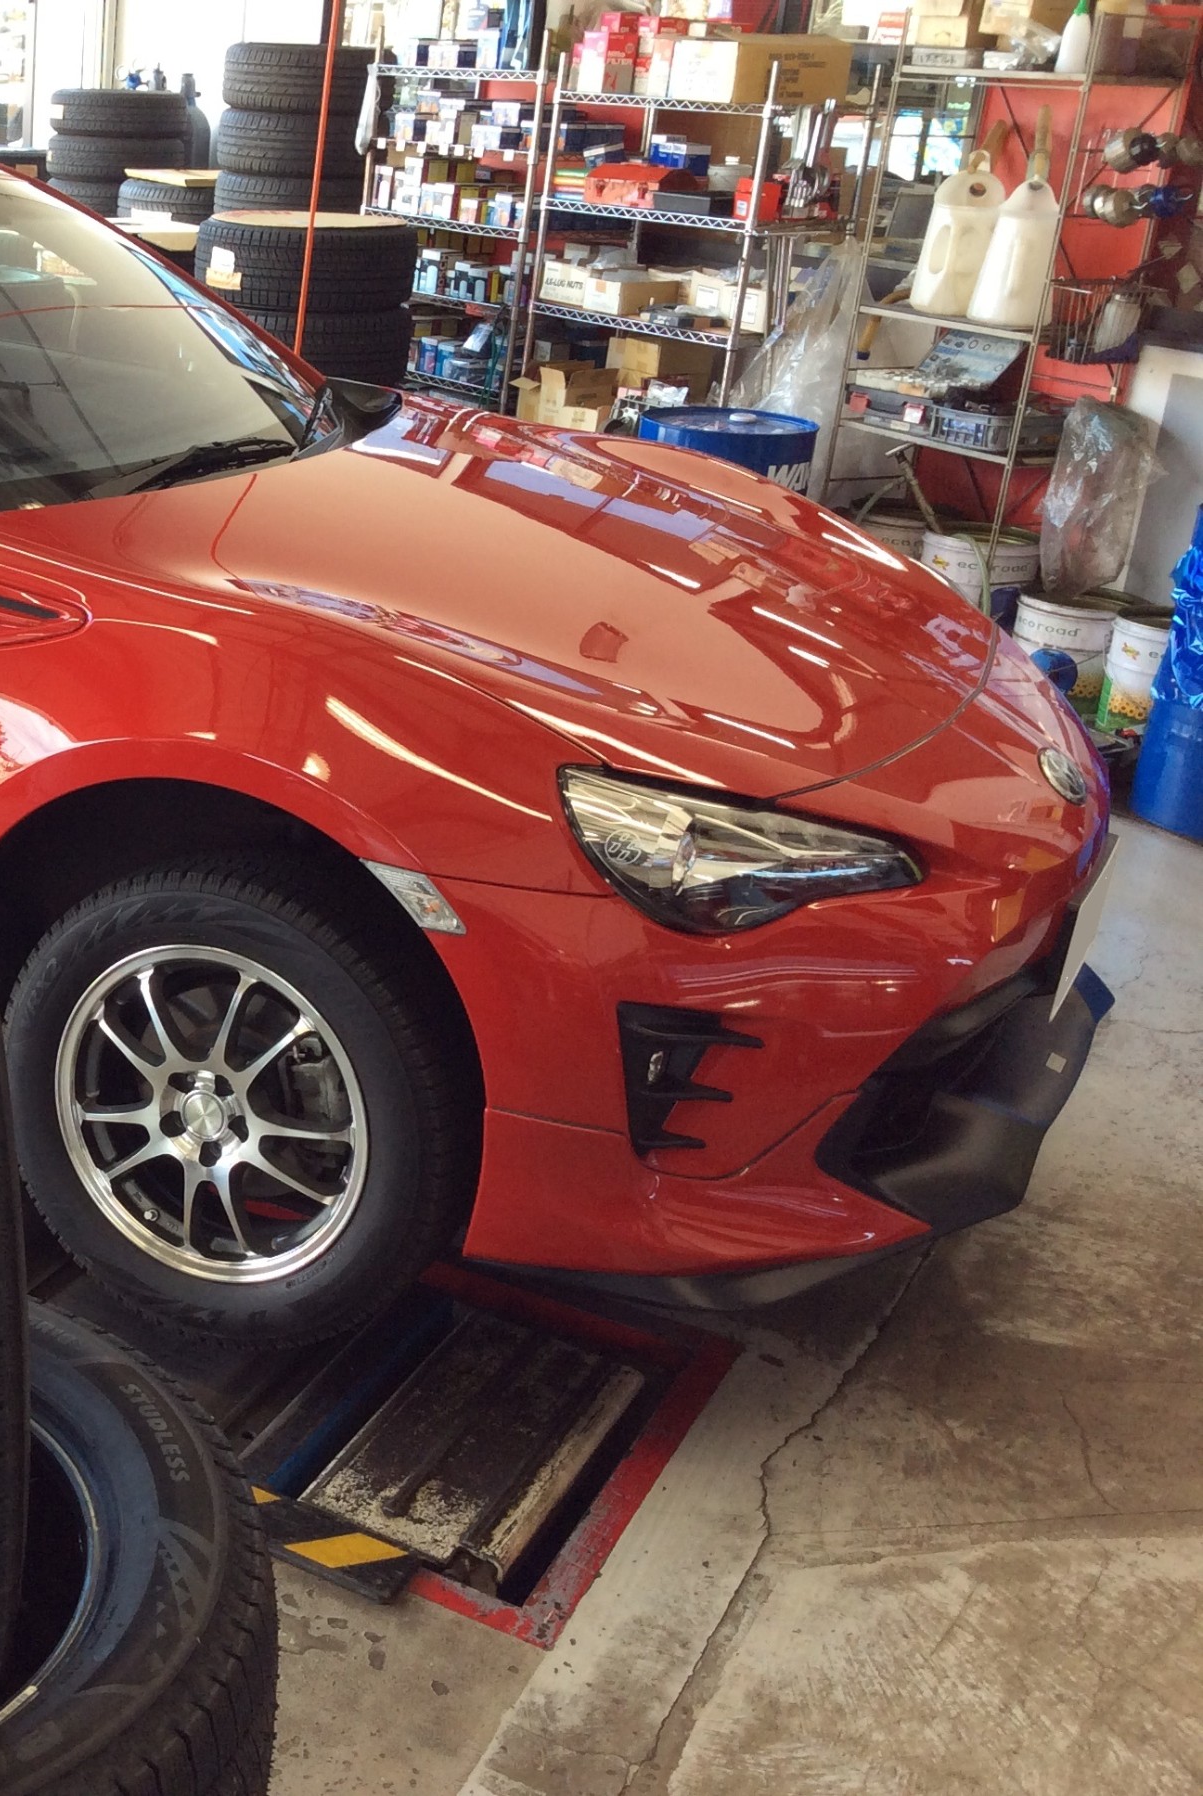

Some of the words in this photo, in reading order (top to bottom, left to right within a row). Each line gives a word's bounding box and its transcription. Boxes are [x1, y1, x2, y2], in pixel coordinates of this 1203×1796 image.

[566, 278, 585, 291] NUTS
[957, 560, 1030, 574] ecroad
[118, 1380, 191, 1484] STUDLESS
